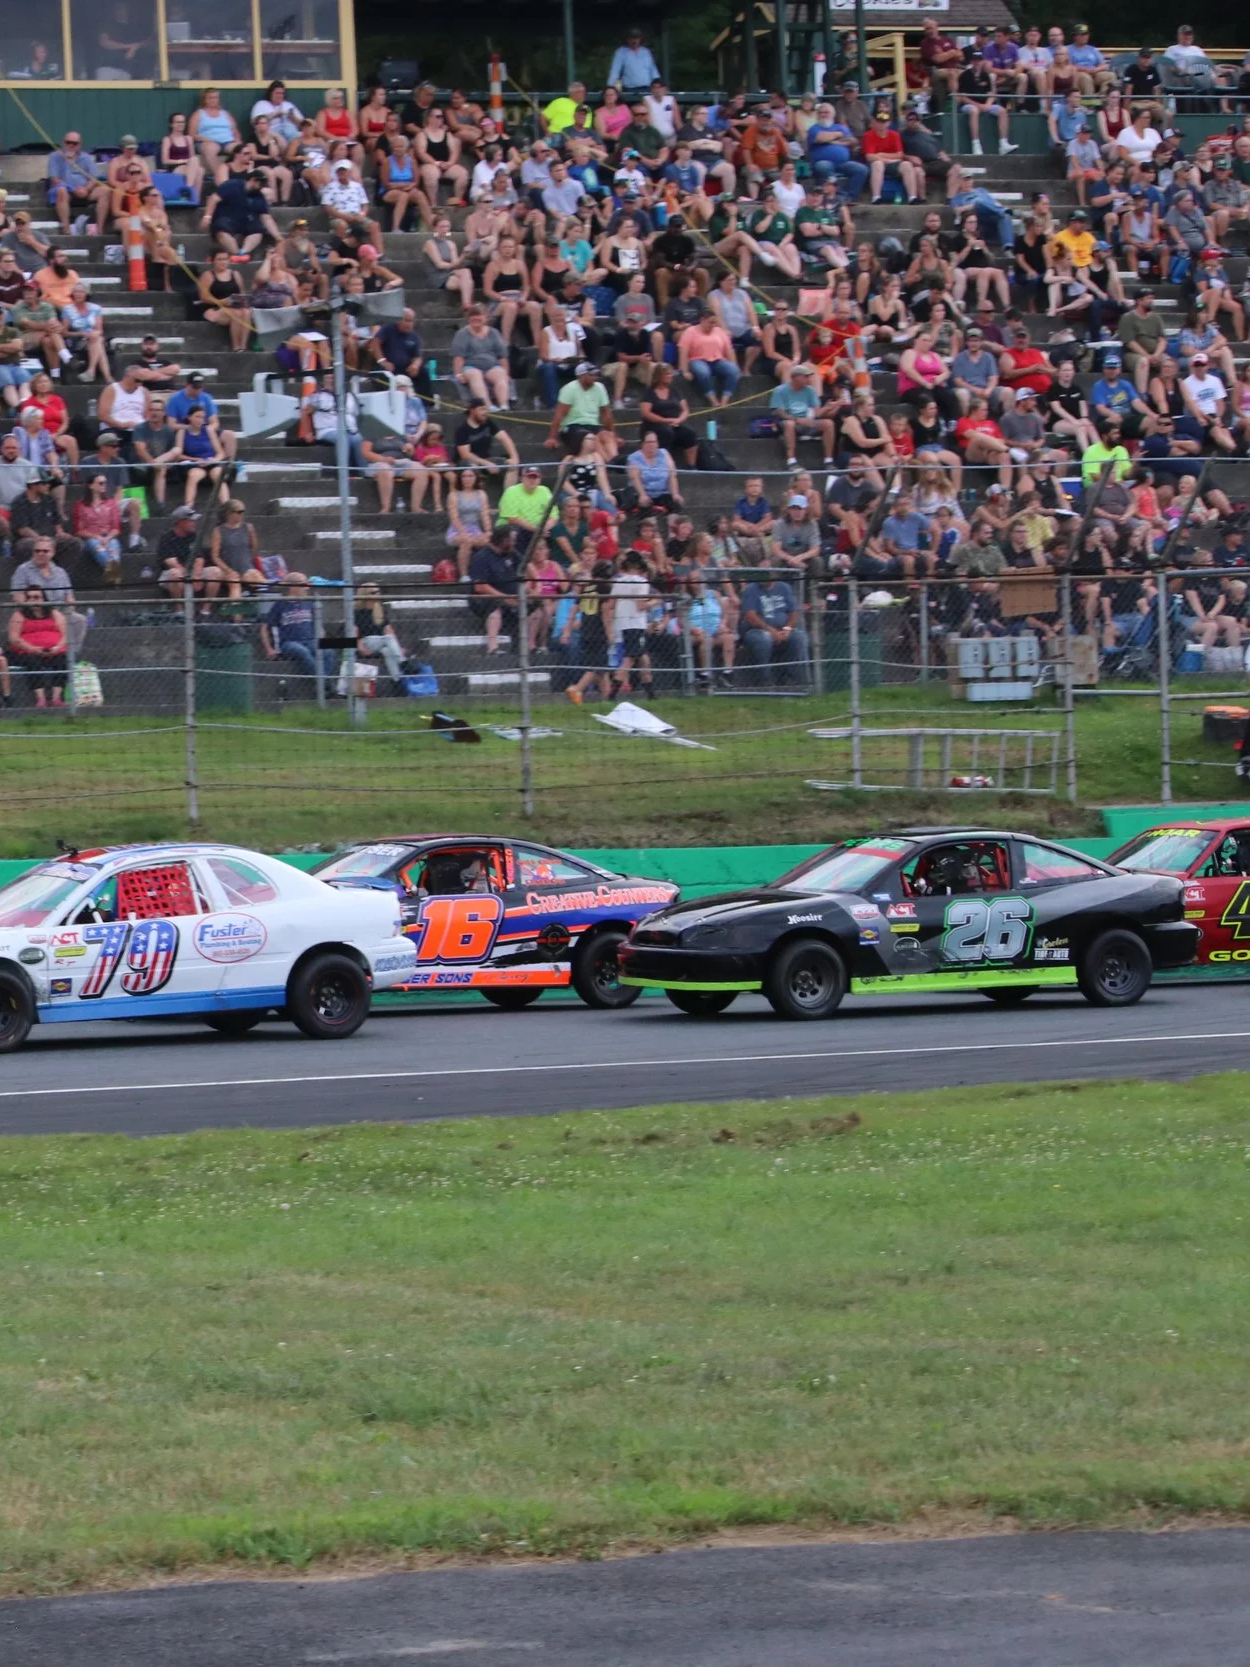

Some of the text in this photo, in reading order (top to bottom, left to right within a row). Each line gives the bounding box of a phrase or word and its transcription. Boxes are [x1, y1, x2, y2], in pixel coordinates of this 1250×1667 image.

[198, 922, 248, 942] Fuster
[414, 895, 503, 964] 16
[787, 913, 823, 925] Hoosier
[942, 898, 1034, 964] 26
[78, 919, 180, 1000] 79
[434, 973, 473, 984] SONS
